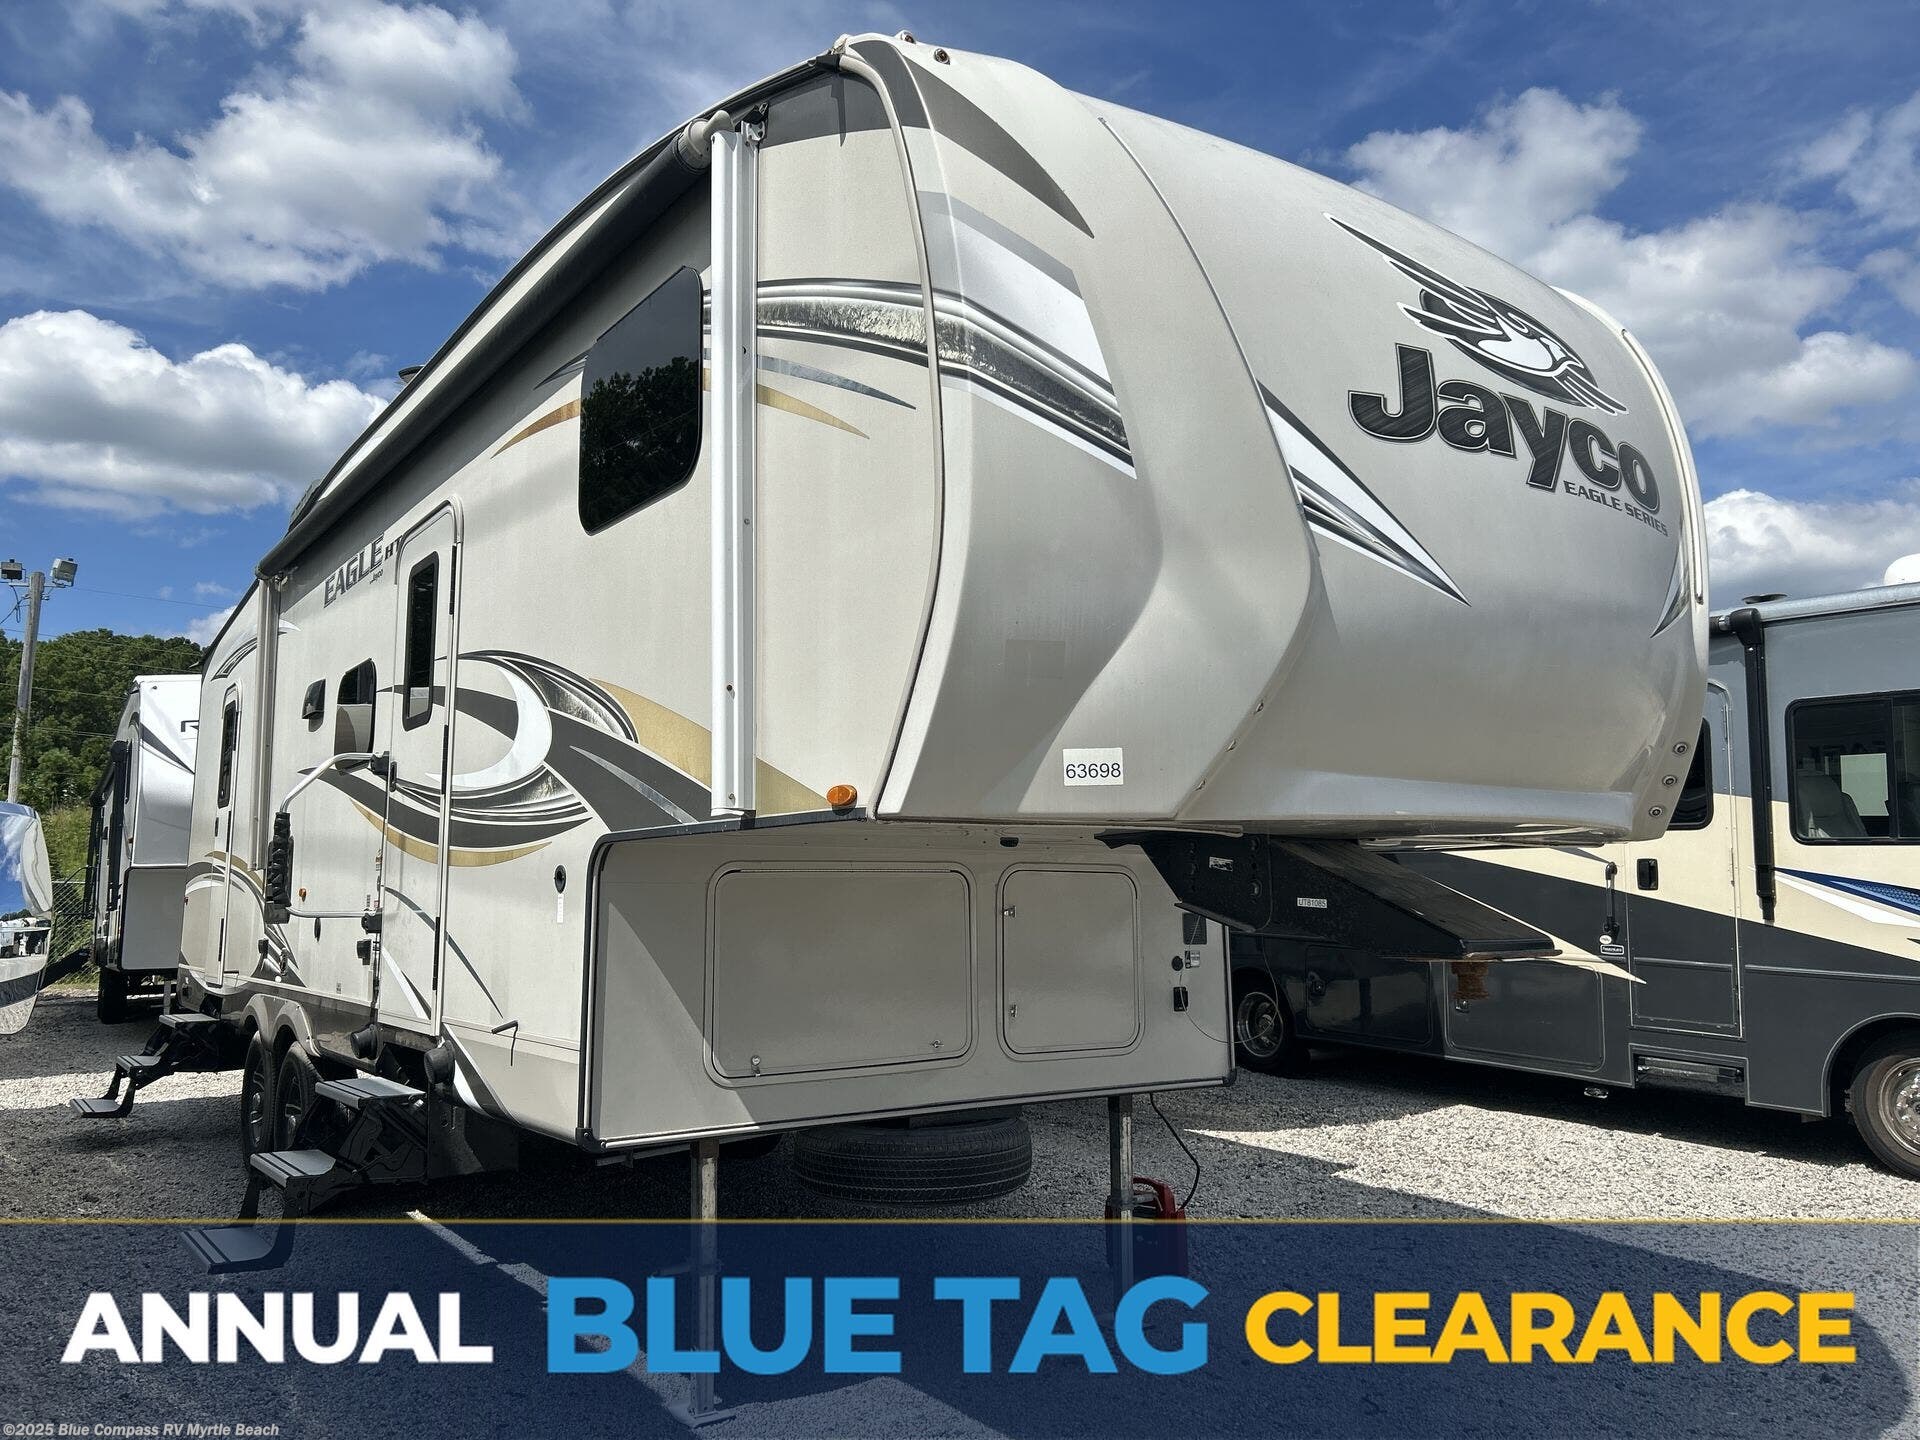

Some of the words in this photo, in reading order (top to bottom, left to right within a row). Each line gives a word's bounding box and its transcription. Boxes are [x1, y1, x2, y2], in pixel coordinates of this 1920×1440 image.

[1349, 343, 1660, 513] Jayco
[1564, 481, 1622, 512] EAGLE
[1625, 503, 1668, 537] SERIES
[324, 533, 384, 608] EAGLE
[1066, 763, 1121, 779] 63698
